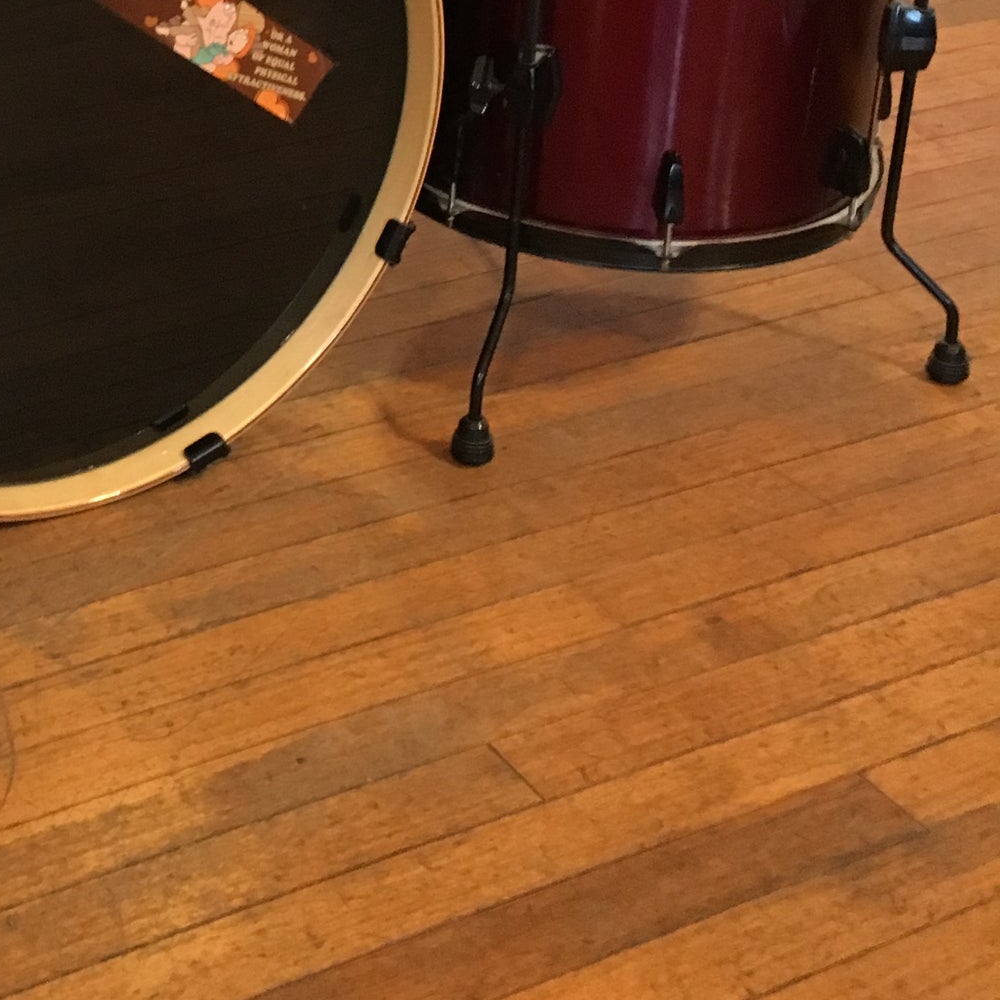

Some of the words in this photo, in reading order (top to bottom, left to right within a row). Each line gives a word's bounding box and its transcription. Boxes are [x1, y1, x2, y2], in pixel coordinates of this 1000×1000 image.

[262, 40, 299, 58] WOMAN
[265, 55, 296, 72] EQUAL
[254, 65, 299, 87] PHYSICAL
